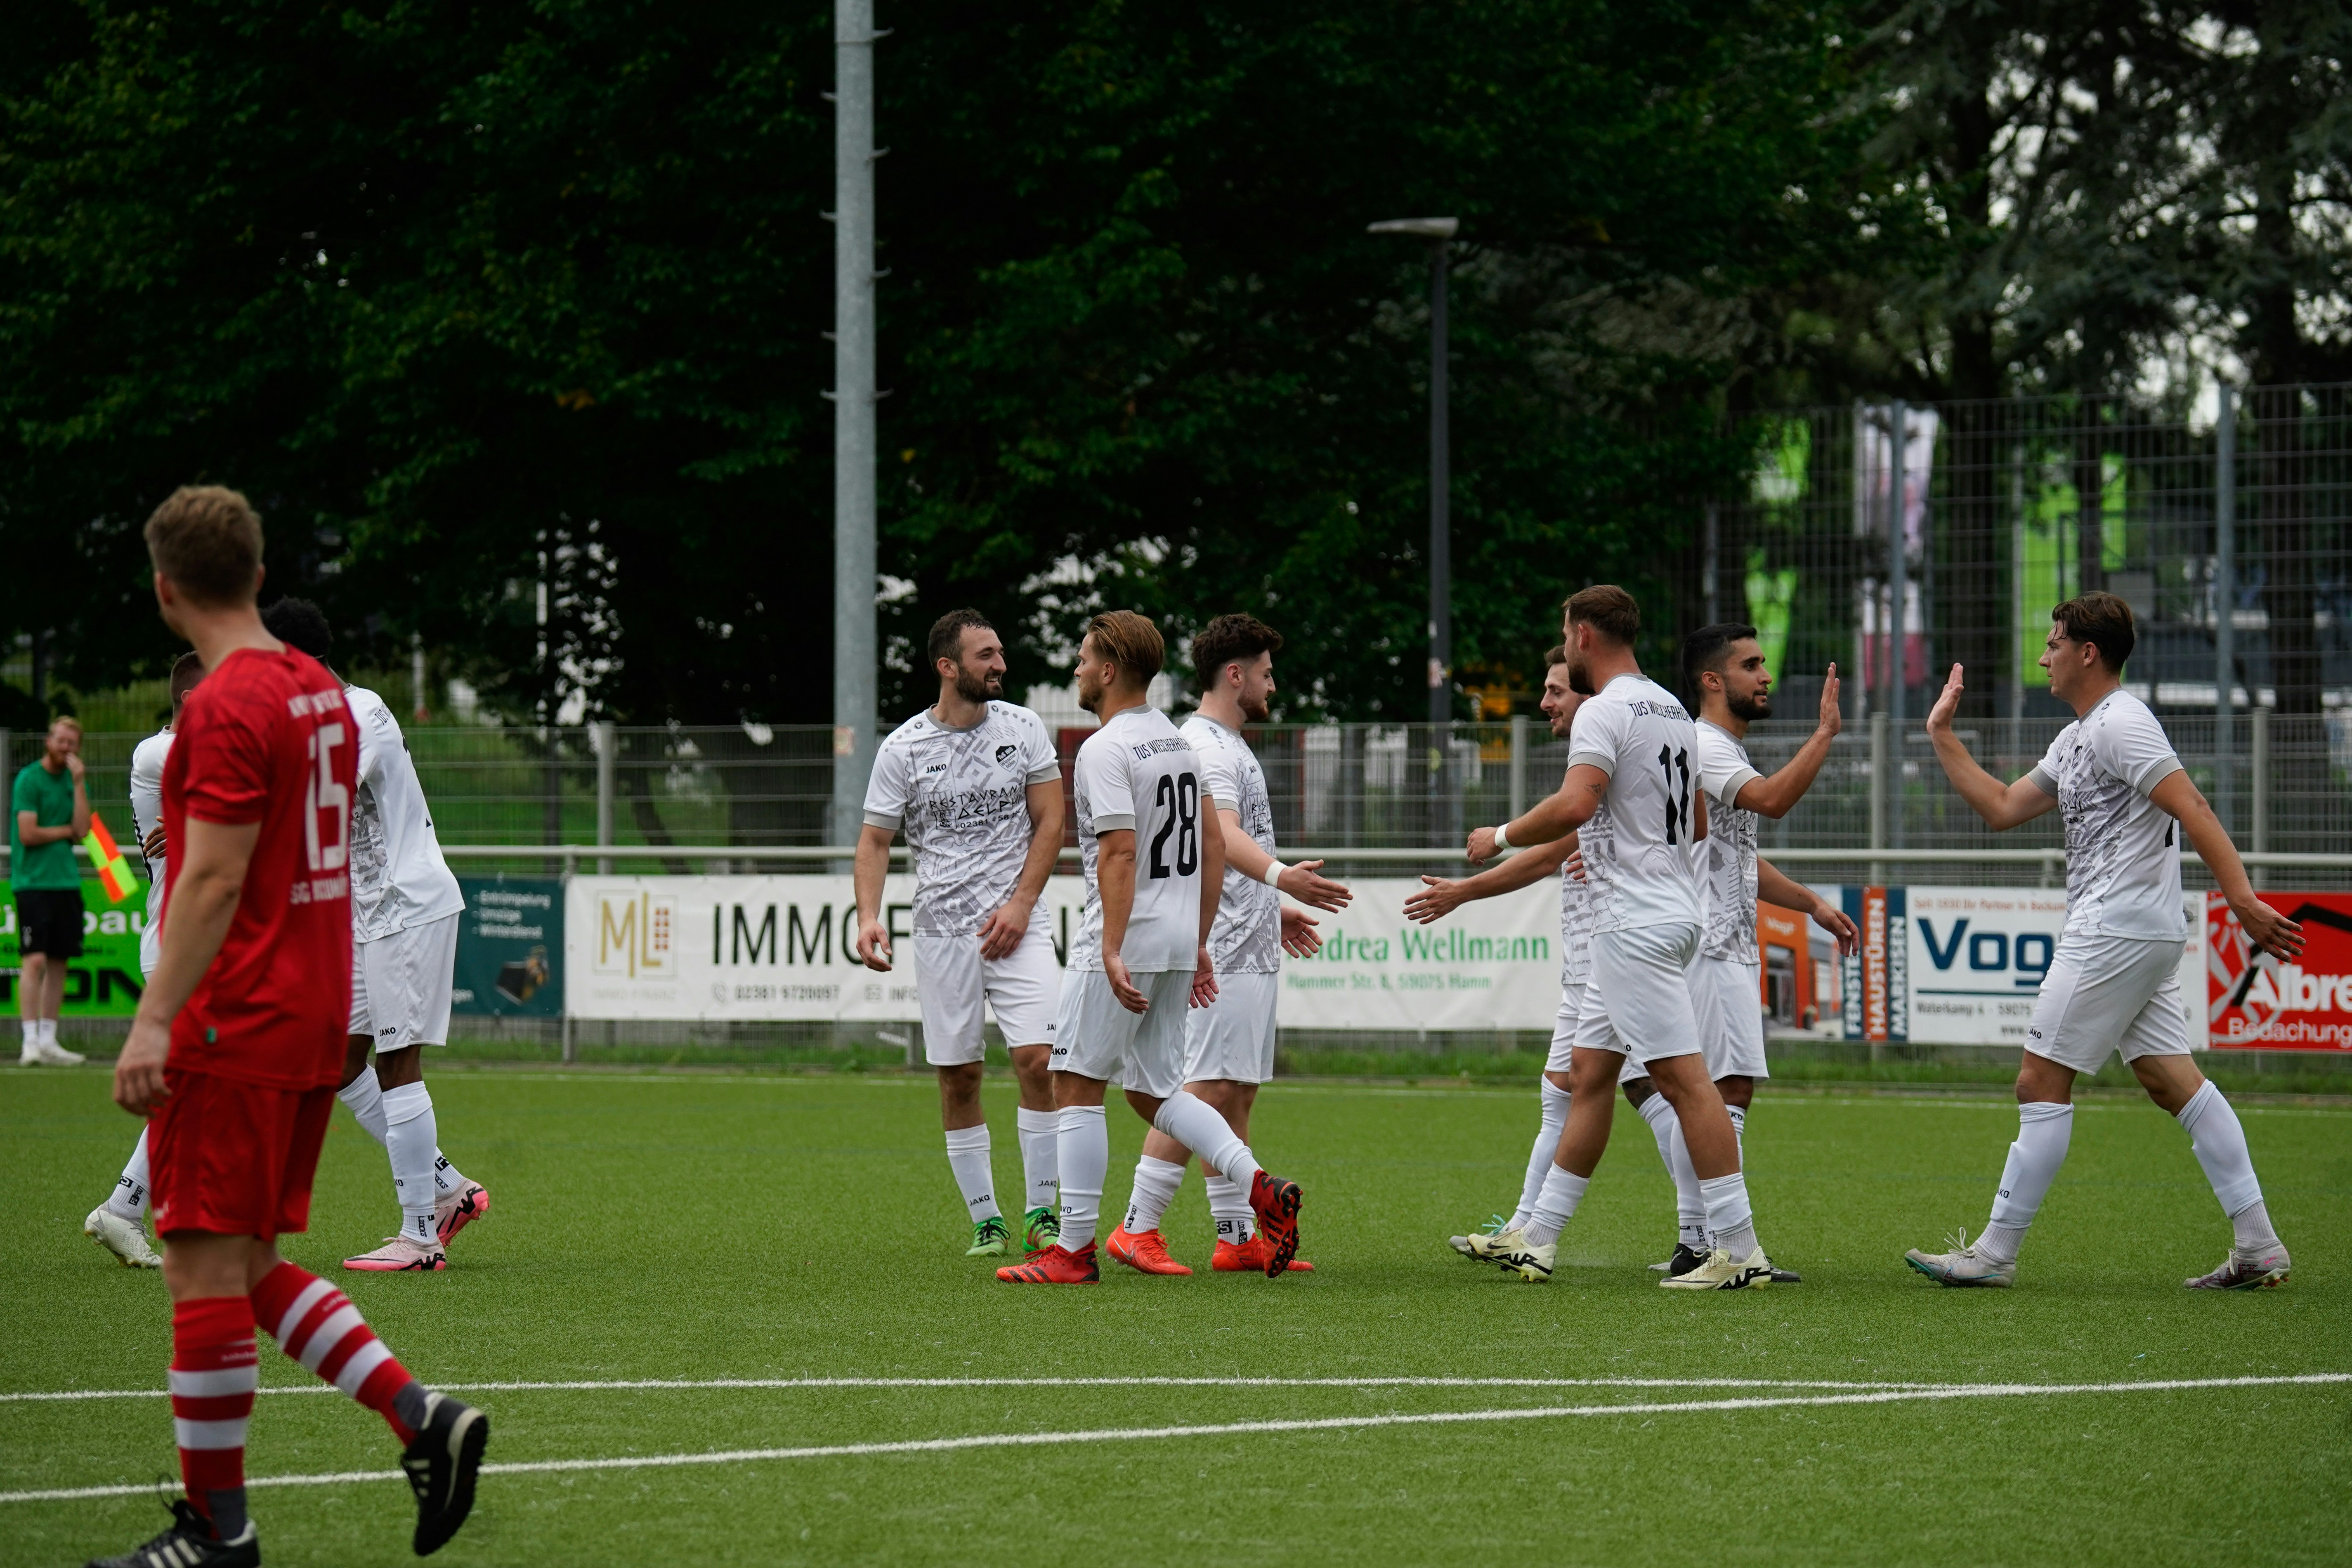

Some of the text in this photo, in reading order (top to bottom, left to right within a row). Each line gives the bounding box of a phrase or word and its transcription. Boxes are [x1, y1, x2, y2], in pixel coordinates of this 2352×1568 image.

[1628, 701, 1648, 717] TUS
[926, 763, 947, 773] JAKO
[1133, 744, 1151, 760] TUS
[306, 723, 349, 871] 15
[1658, 743, 1689, 845] 11
[960, 819, 988, 829] 02381
[1149, 772, 1197, 879] 28
[1287, 928, 1549, 962] drea Wellmann
[1917, 917, 2060, 987] Vog
[1287, 972, 1345, 989] Hammer
[1865, 897, 1886, 1035] HAUSTÜREN
[1889, 916, 1907, 1036] MARKISEN
[1844, 949, 1862, 1035] FENSTE
[380, 1027, 396, 1037] JAKO
[969, 1194, 990, 1206] JAKO
